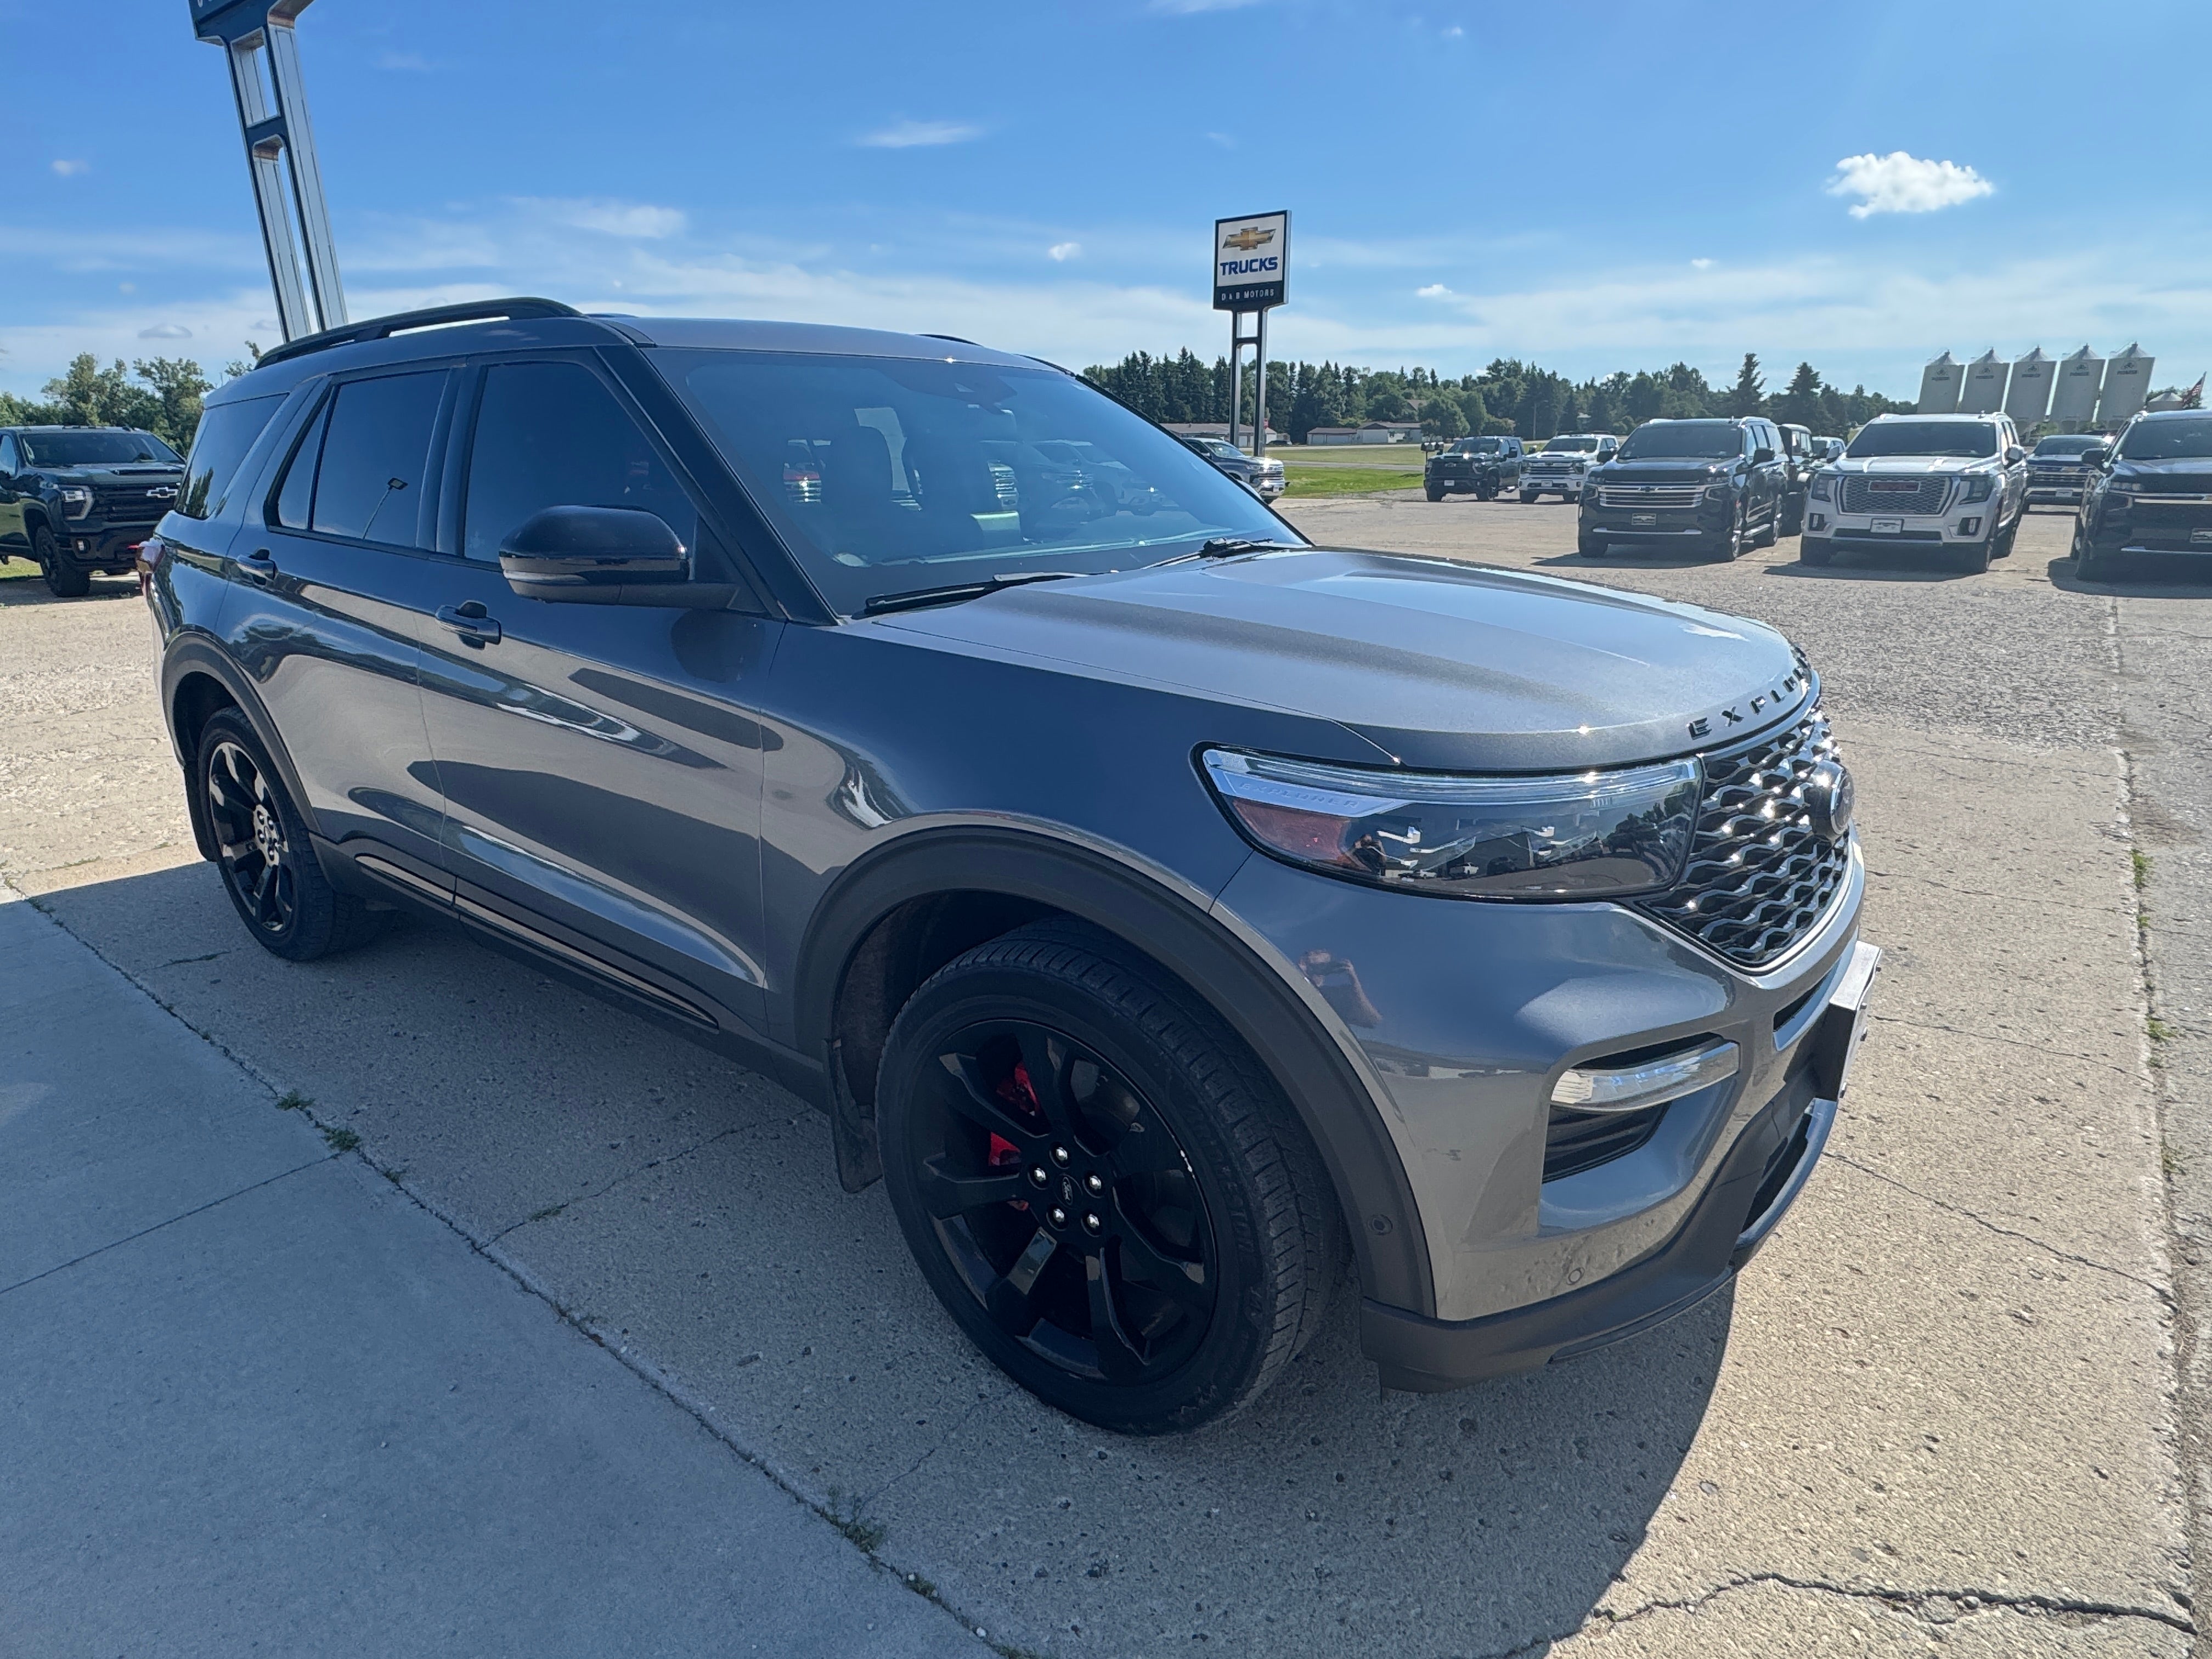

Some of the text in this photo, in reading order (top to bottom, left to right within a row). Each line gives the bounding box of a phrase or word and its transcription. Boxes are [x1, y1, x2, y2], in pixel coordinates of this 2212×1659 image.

[1220, 256, 1278, 275] TRUCKS
[1244, 289, 1274, 298] MOTORS
[1688, 646, 1810, 740] EXPLO
[1238, 782, 1359, 809] EXPLORER
